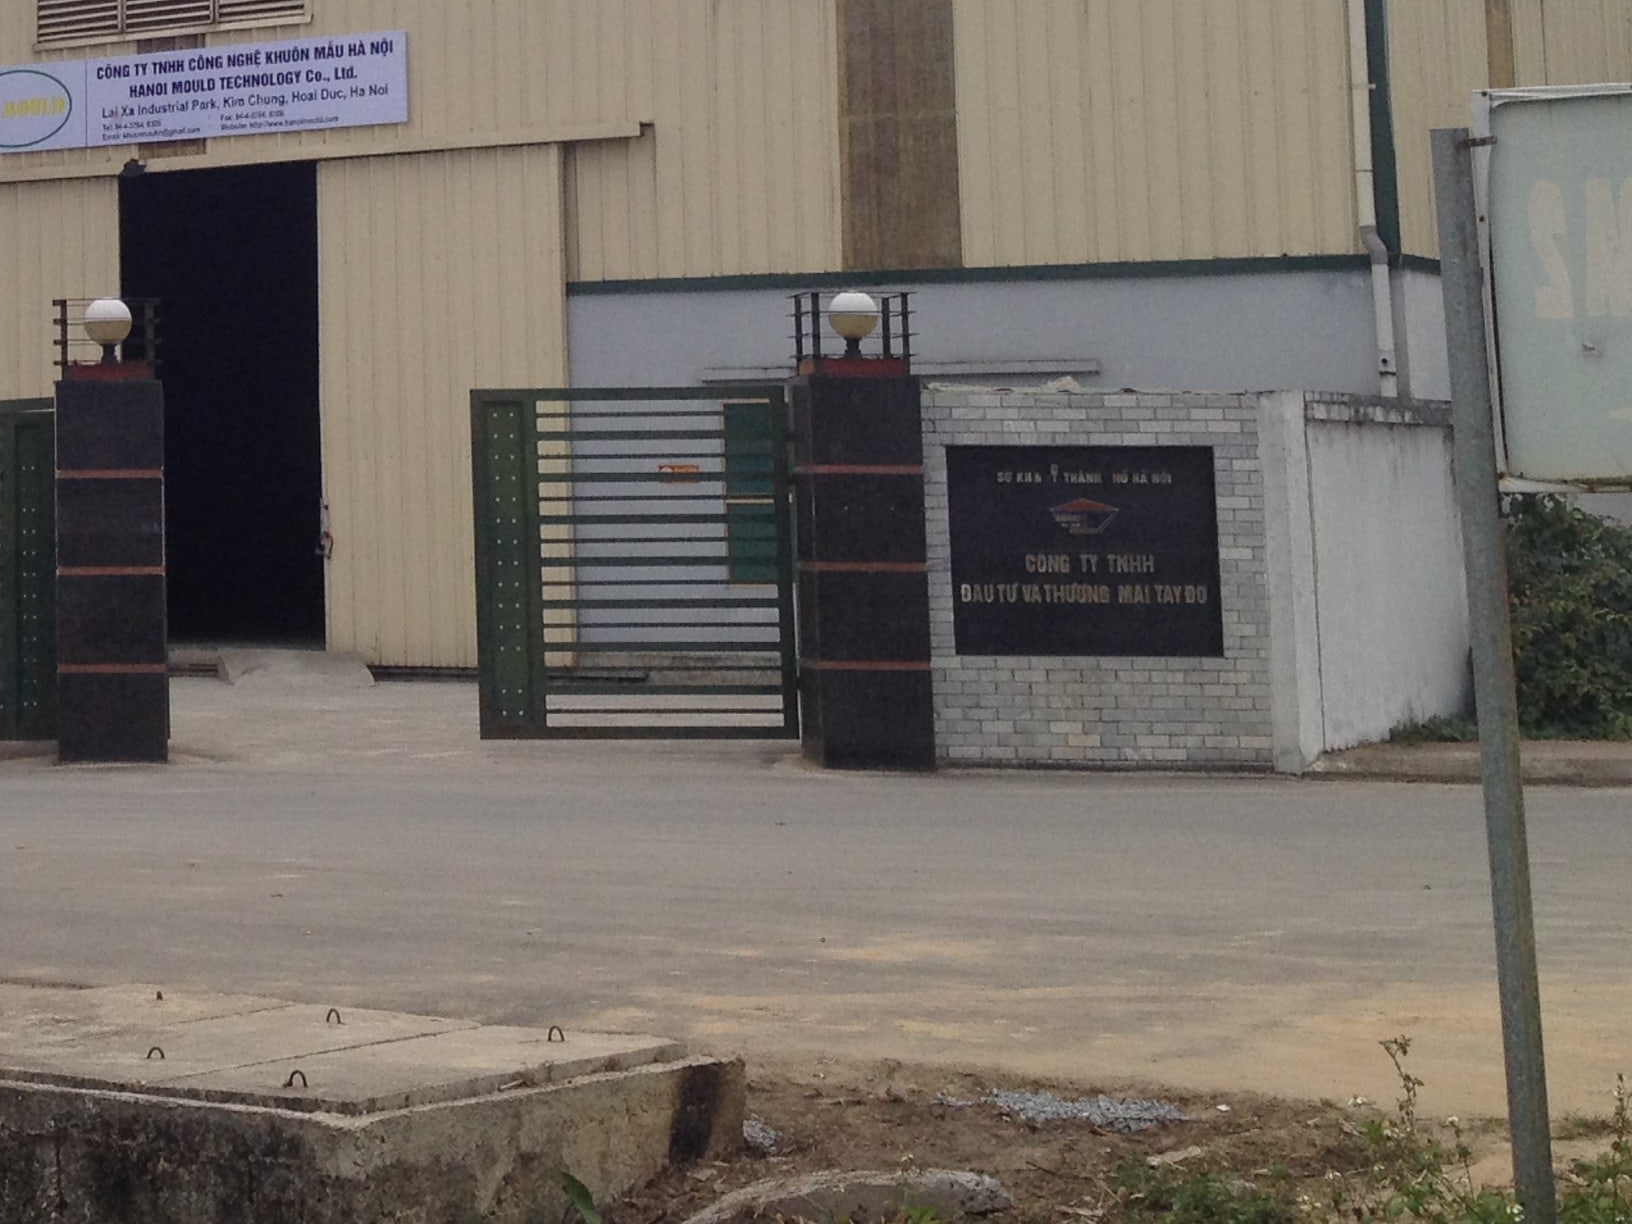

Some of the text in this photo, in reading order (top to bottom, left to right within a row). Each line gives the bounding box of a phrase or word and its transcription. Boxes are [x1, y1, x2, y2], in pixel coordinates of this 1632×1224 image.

[97, 64, 130, 80] CÔNG
[134, 62, 148, 77] TY
[151, 60, 185, 75] TNHH
[188, 55, 223, 72] CÔNG
[227, 50, 262, 68] NGHỆ
[265, 46, 310, 65] KHUÔN
[348, 40, 366, 57] HÀ
[370, 38, 394, 57] NỘI
[129, 82, 168, 98] HANOI
[172, 78, 215, 95] MOULD
[219, 70, 302, 91] TECHNOLOGY
[334, 66, 358, 81] Ltd.
[138, 101, 189, 116] Industrial
[192, 97, 220, 111] Park,
[223, 95, 245, 108] Kim
[350, 86, 365, 98] Ha
[369, 83, 388, 96] Noi
[1080, 553, 1098, 574] TY
[1106, 553, 1155, 574] TNHH
